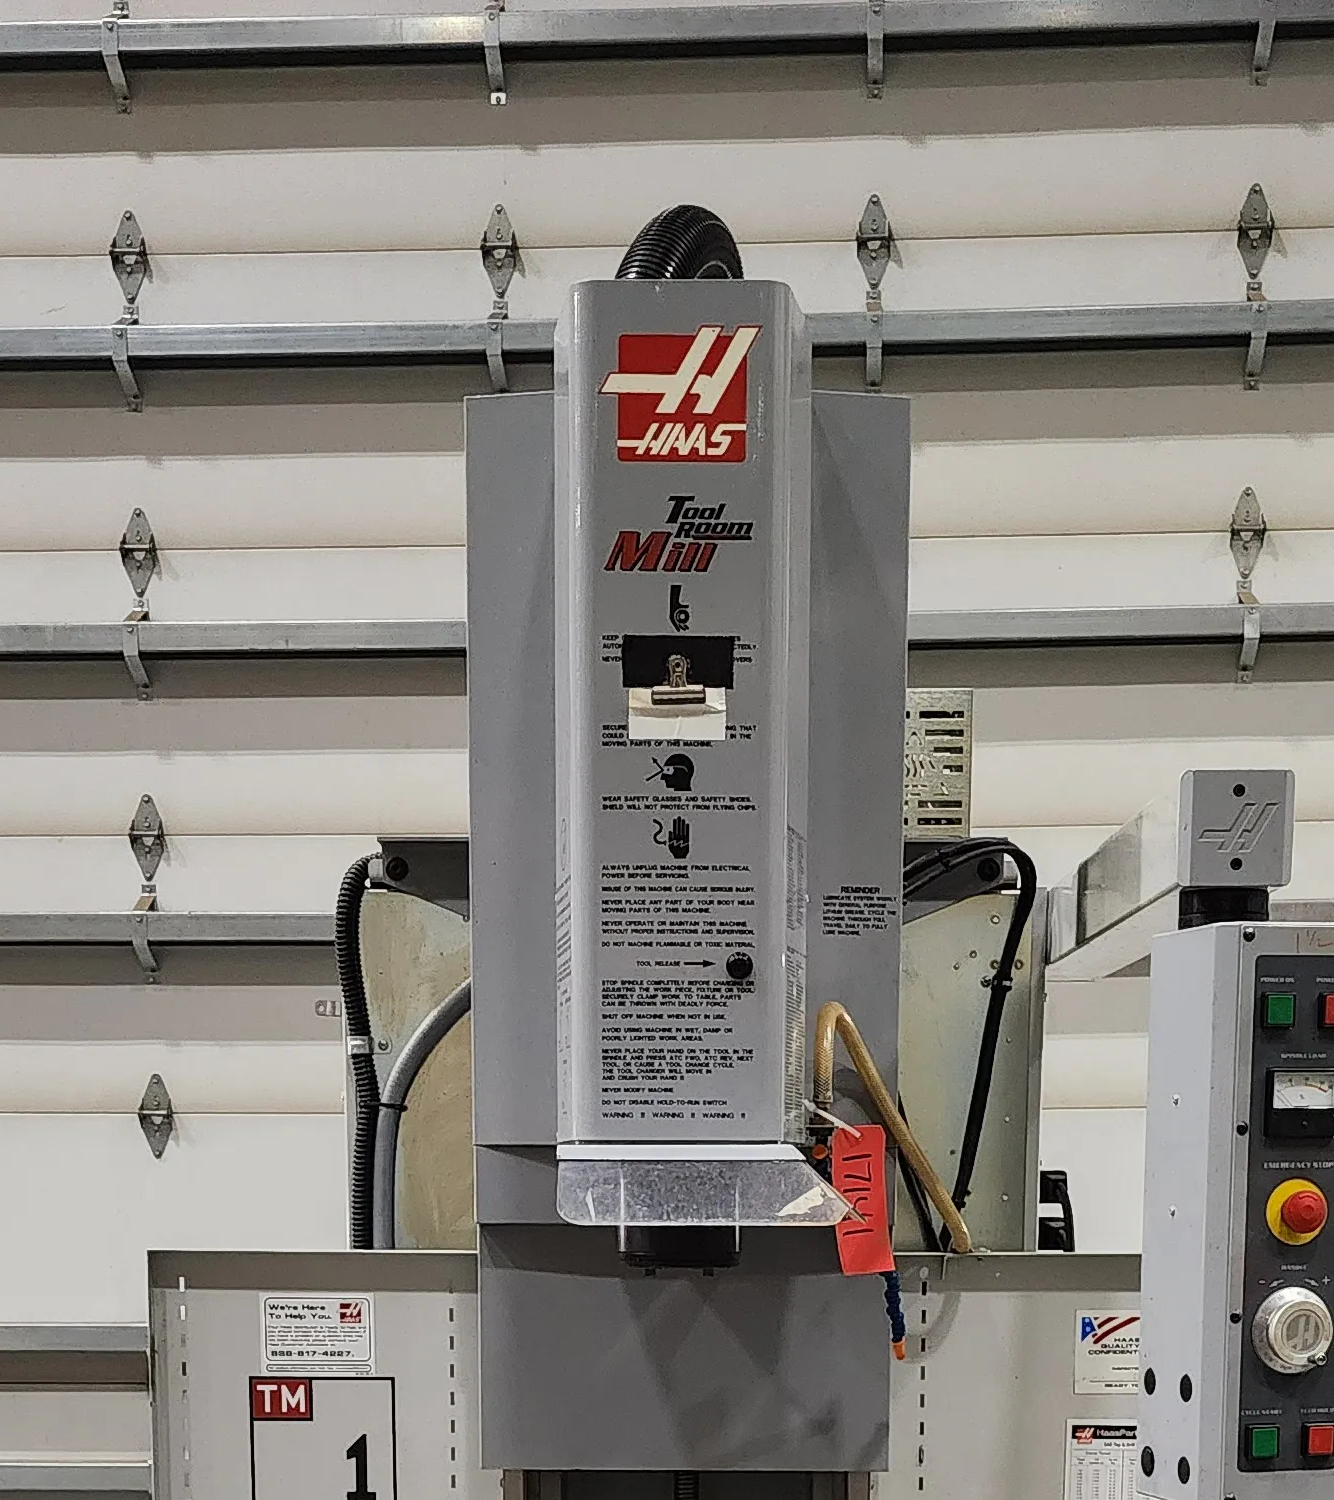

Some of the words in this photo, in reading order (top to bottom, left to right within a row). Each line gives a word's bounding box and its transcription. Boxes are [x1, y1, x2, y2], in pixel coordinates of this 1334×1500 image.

[617, 423, 746, 455] HAAS
[667, 496, 727, 524] Tool
[674, 521, 754, 540] Room
[603, 531, 718, 572] Mill
[256, 1384, 306, 1413] TM
